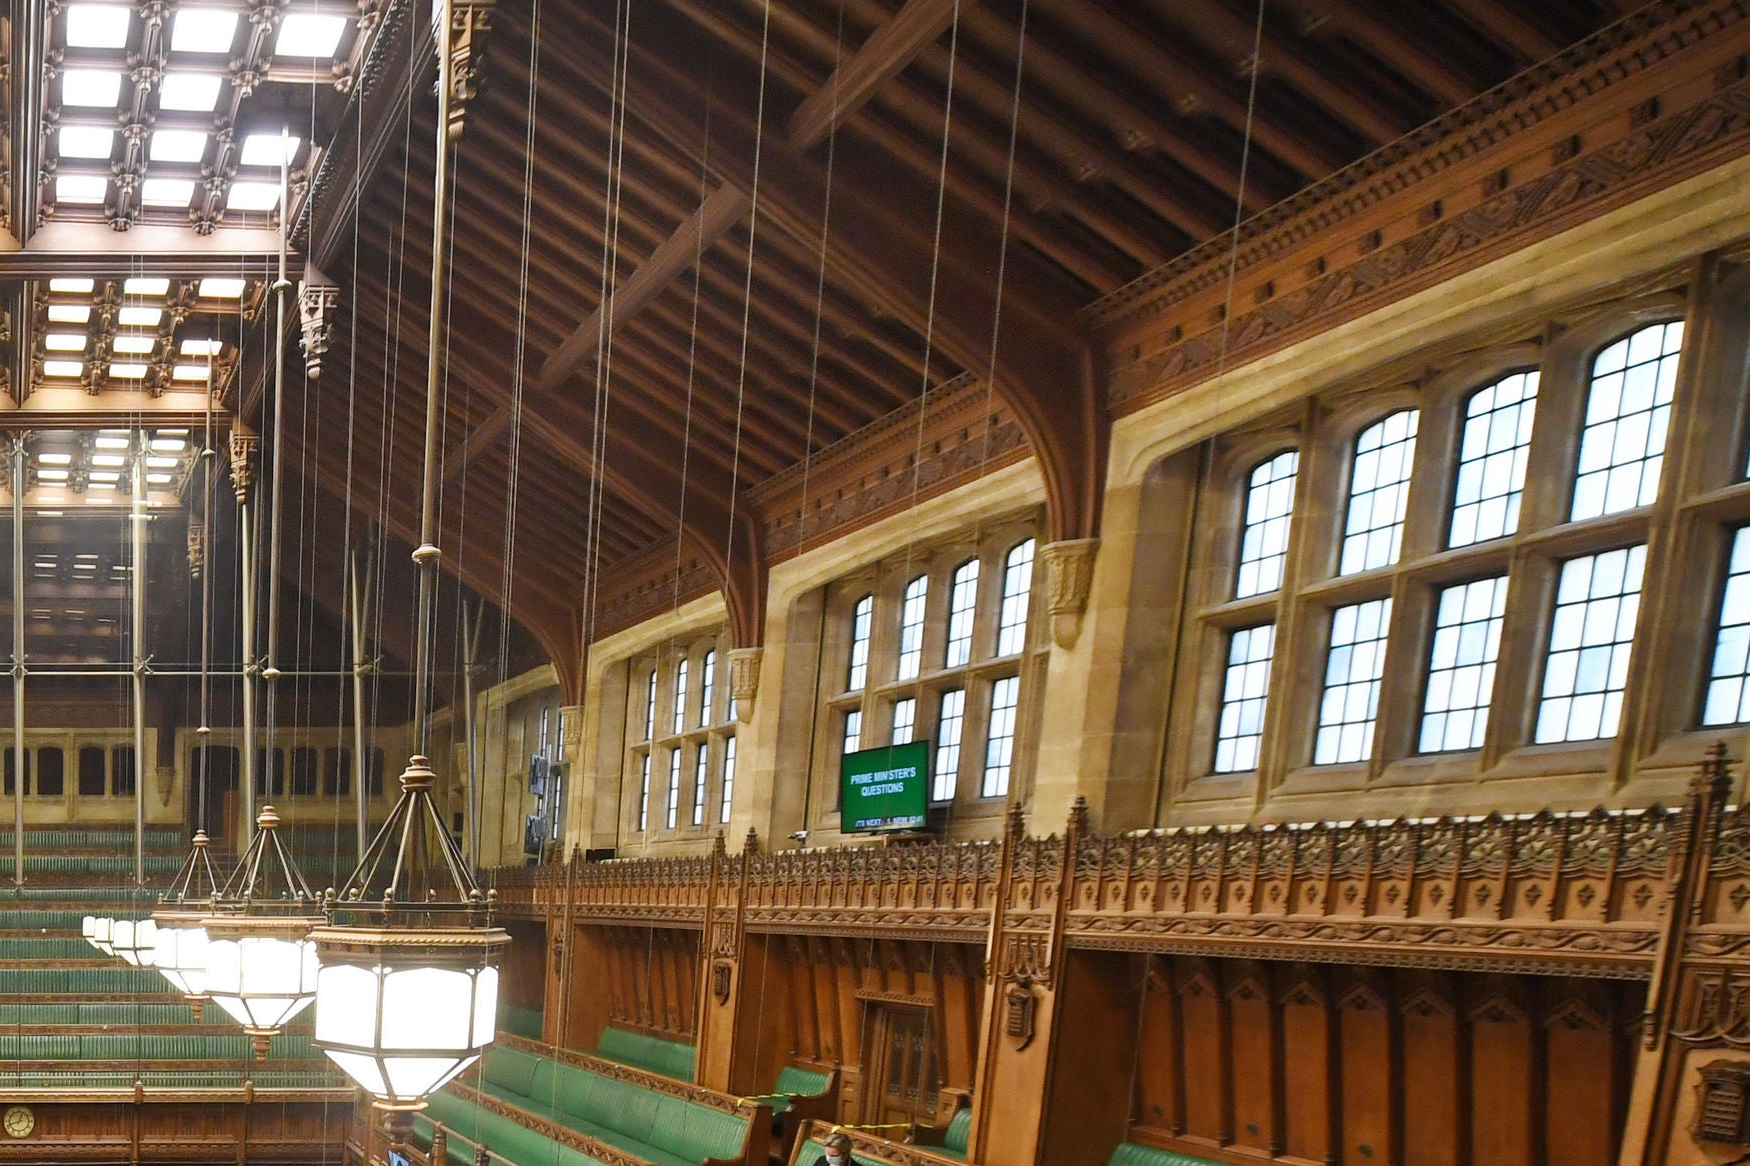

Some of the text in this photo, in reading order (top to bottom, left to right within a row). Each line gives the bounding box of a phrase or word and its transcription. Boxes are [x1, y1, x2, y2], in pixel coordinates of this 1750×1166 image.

[850, 767, 916, 785] PRIME MINSTER'S
[861, 782, 904, 797] QUESTIONS
